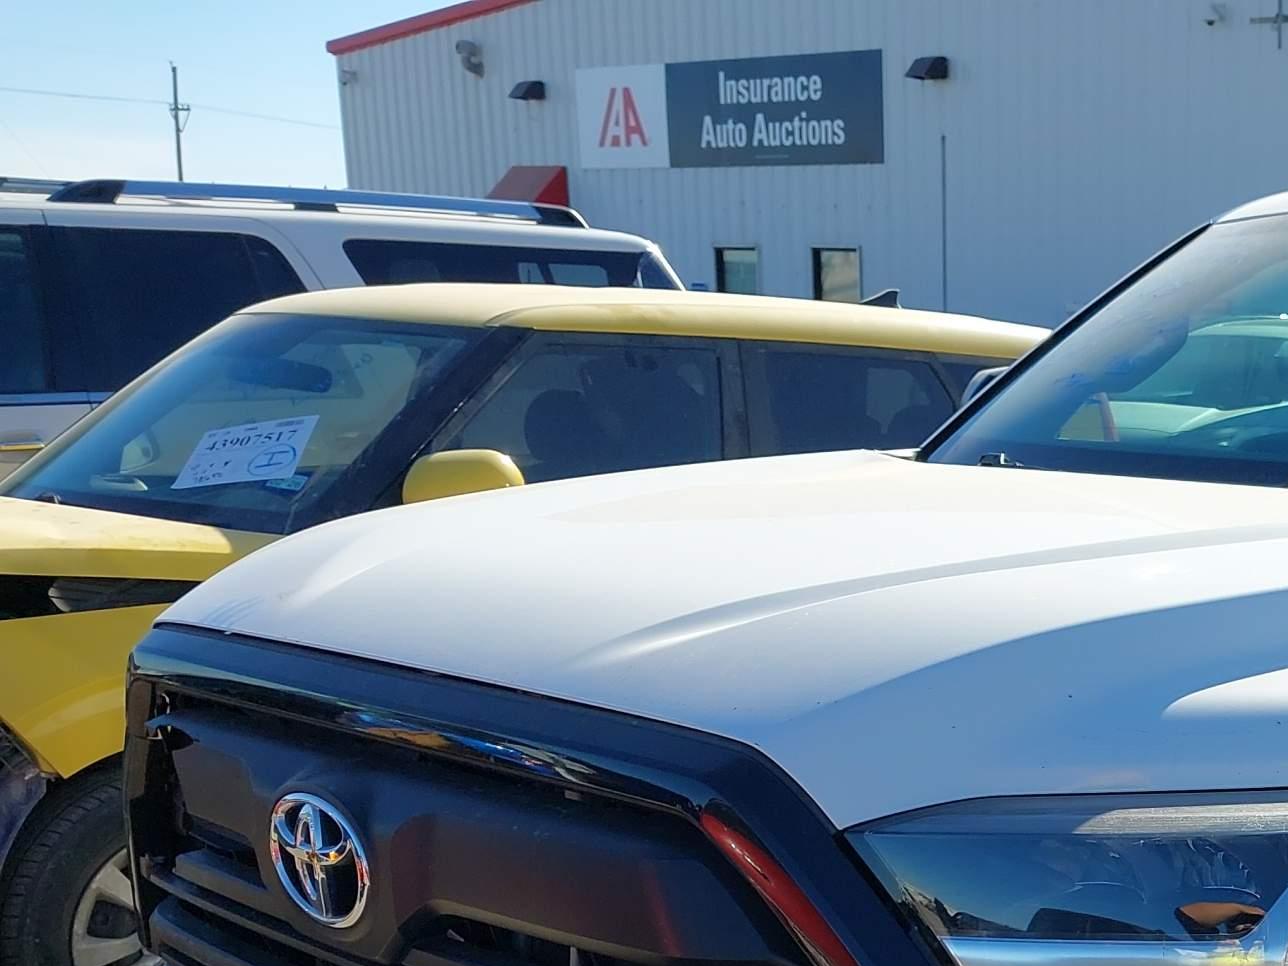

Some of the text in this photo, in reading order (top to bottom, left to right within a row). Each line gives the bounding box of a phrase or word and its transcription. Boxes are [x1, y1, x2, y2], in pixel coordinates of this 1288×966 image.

[718, 71, 823, 105] Insurance
[700, 111, 845, 149] Auto Auctions
[206, 430, 298, 451] 43907517
